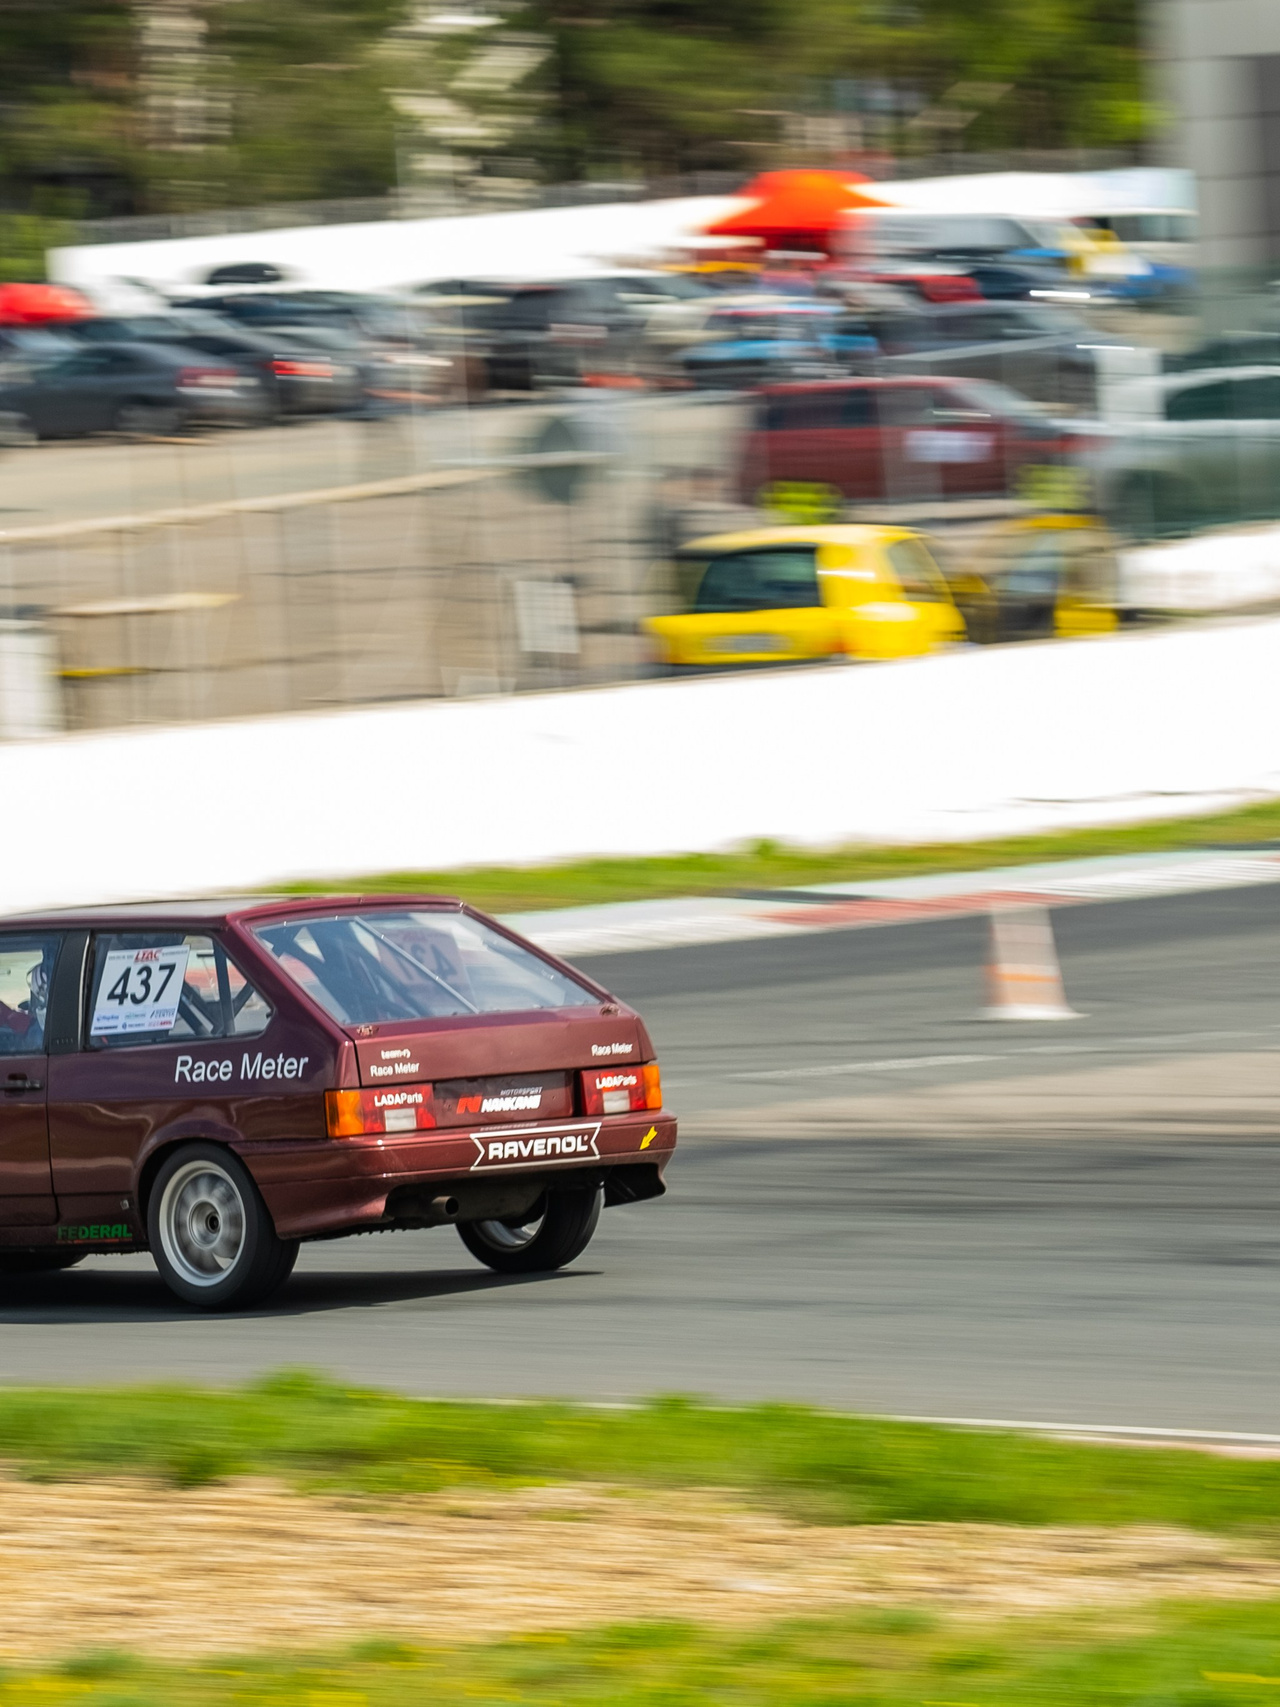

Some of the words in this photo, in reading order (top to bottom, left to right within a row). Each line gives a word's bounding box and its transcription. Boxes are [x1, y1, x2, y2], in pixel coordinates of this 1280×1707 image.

[107, 962, 176, 1005] 437
[591, 1044, 611, 1056] Race
[611, 1043, 633, 1054] Meter
[174, 1055, 233, 1083] Race
[240, 1052, 309, 1080] Meter
[370, 1065, 393, 1077] Race
[395, 1062, 420, 1075] Meter
[595, 1075, 637, 1090] LADAParts
[500, 1087, 542, 1096] MOTORSPORT
[374, 1092, 423, 1107] LADAParts
[481, 1095, 541, 1113] NANKANG
[488, 1135, 588, 1160] RAVENOL
[57, 1224, 133, 1240] FEDERAL
